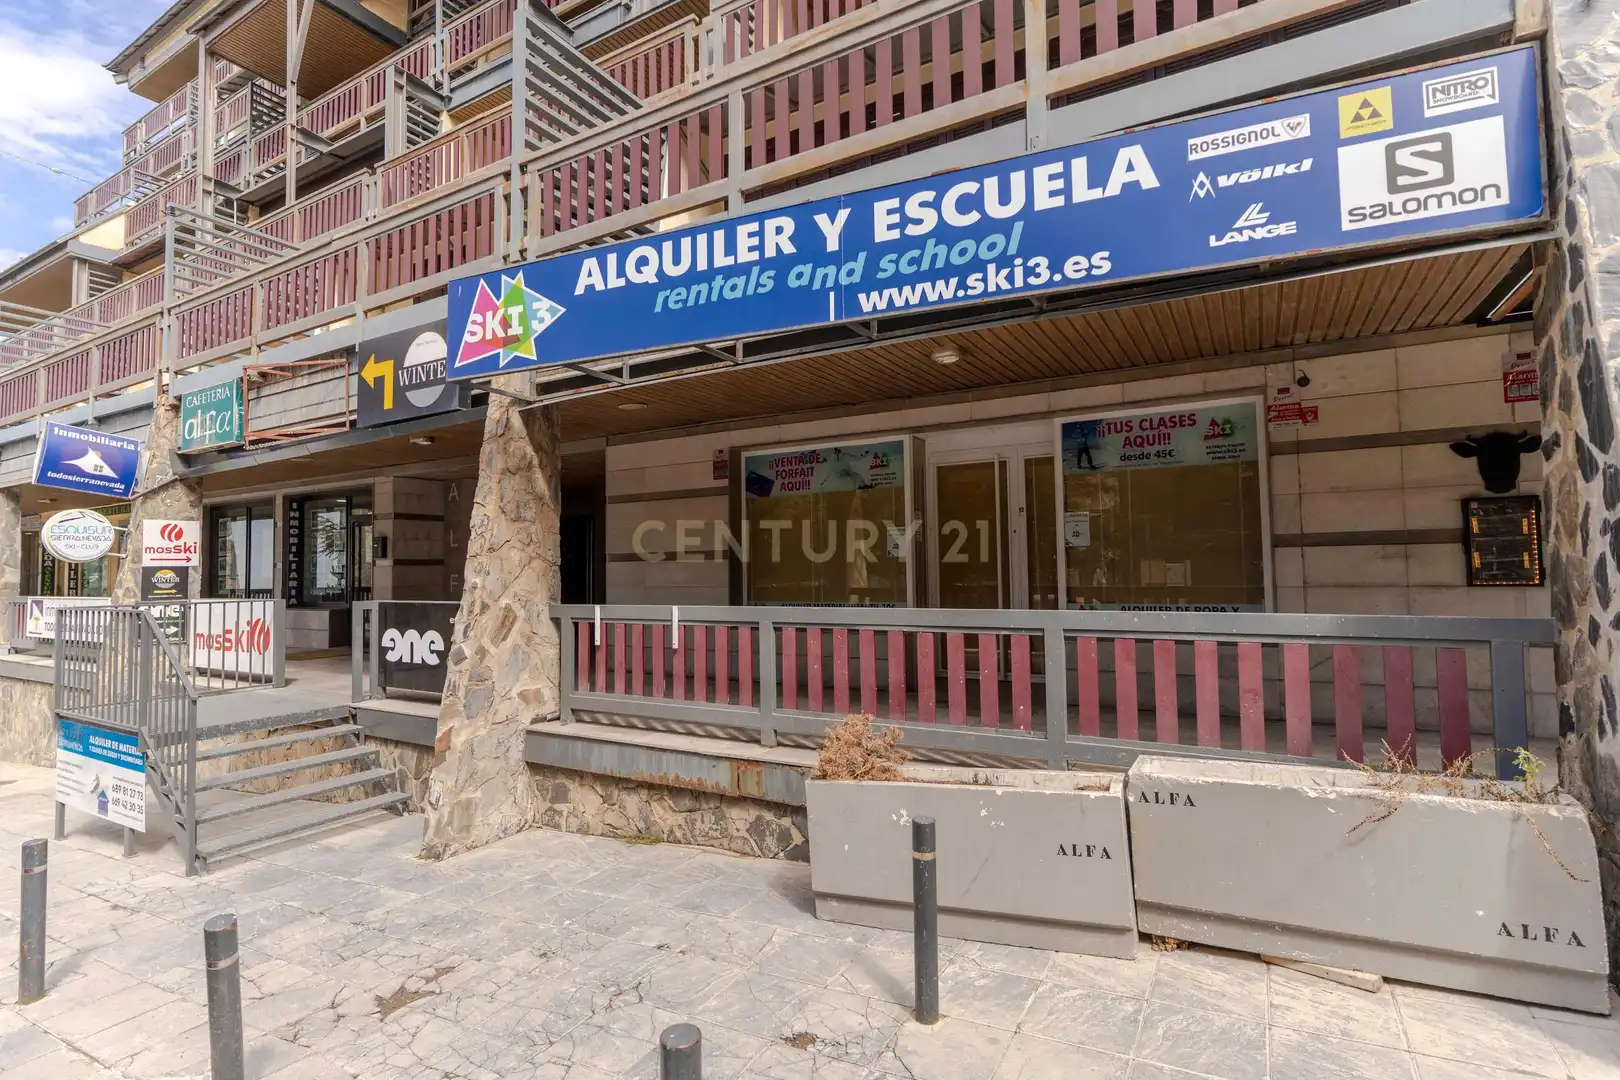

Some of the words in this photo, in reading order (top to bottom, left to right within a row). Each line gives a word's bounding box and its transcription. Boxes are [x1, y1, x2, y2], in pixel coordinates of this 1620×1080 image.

[1431, 76, 1489, 99] NITRO
[1188, 126, 1281, 156] ROSSIGNOL
[1216, 158, 1314, 188] Völkl
[574, 215, 797, 296] ALQUILER
[813, 207, 852, 253] Y
[874, 144, 1161, 243] ESCUELA
[1209, 220, 1298, 247] LANGE
[654, 264, 777, 313] rentals
[787, 250, 867, 291] and
[876, 220, 1025, 280] school
[857, 250, 1113, 313] www.ski3.es
[465, 304, 524, 343] SKI
[531, 301, 552, 332] 3
[398, 359, 446, 387] WINTE
[185, 386, 231, 408] CAFETERIA
[1138, 413, 1197, 432] CLASES
[53, 427, 135, 451] Inmobiliaria
[1122, 429, 1171, 449] AQUÍ!!
[808, 453, 821, 465] DE
[1120, 451, 1152, 462] desde
[1154, 449, 1176, 459] 45€
[47, 470, 126, 490] todosierranevada
[775, 466, 815, 480] FORFAIT
[144, 541, 198, 554] masSki
[288, 502, 300, 605] INMOBILIARIA
[150, 576, 181, 584] WINTER
[112, 740, 119, 750] DE
[1138, 790, 1197, 808] ALFA
[1056, 843, 1113, 860] ALFA
[1497, 920, 1587, 948] ALFA
